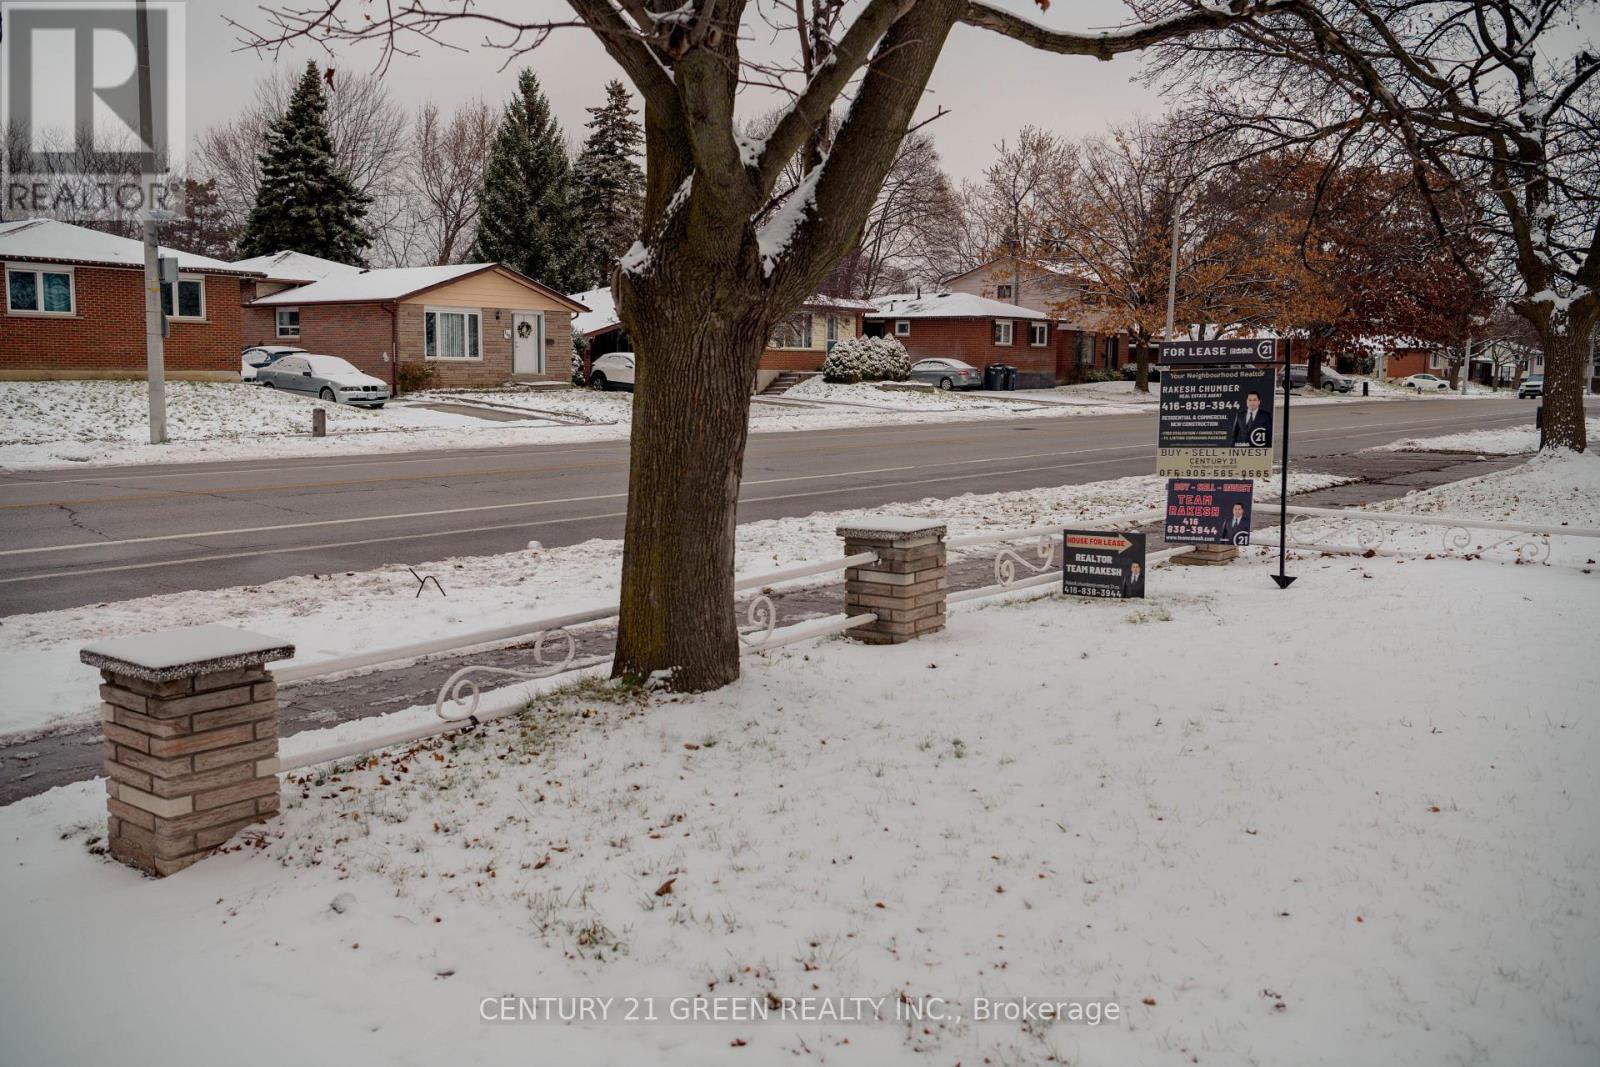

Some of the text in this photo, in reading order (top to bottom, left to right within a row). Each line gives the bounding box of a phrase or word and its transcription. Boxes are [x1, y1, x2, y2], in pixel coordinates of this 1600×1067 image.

[1163, 348, 1185, 357] FOR
[1188, 346, 1227, 357] LEASE
[1186, 371, 1239, 380] Neighbourhood
[1162, 384, 1240, 394] RAKESH CHUMBER
[1161, 401, 1240, 411] 416-838-3944
[1160, 448, 1270, 457] BUY SELL INVEST
[1173, 482, 1191, 492] BUY
[1177, 494, 1213, 506] TEAM
[1168, 505, 1220, 517] RAKESH
[1182, 517, 1200, 526] 416
[1167, 525, 1218, 535] 838-3944
[1067, 536, 1126, 547] HOUSE FOR LEASE
[1075, 553, 1113, 564] REALTOR
[1066, 564, 1122, 577] TEAM RAKESH
[1064, 585, 1122, 598] 416-838-3944
